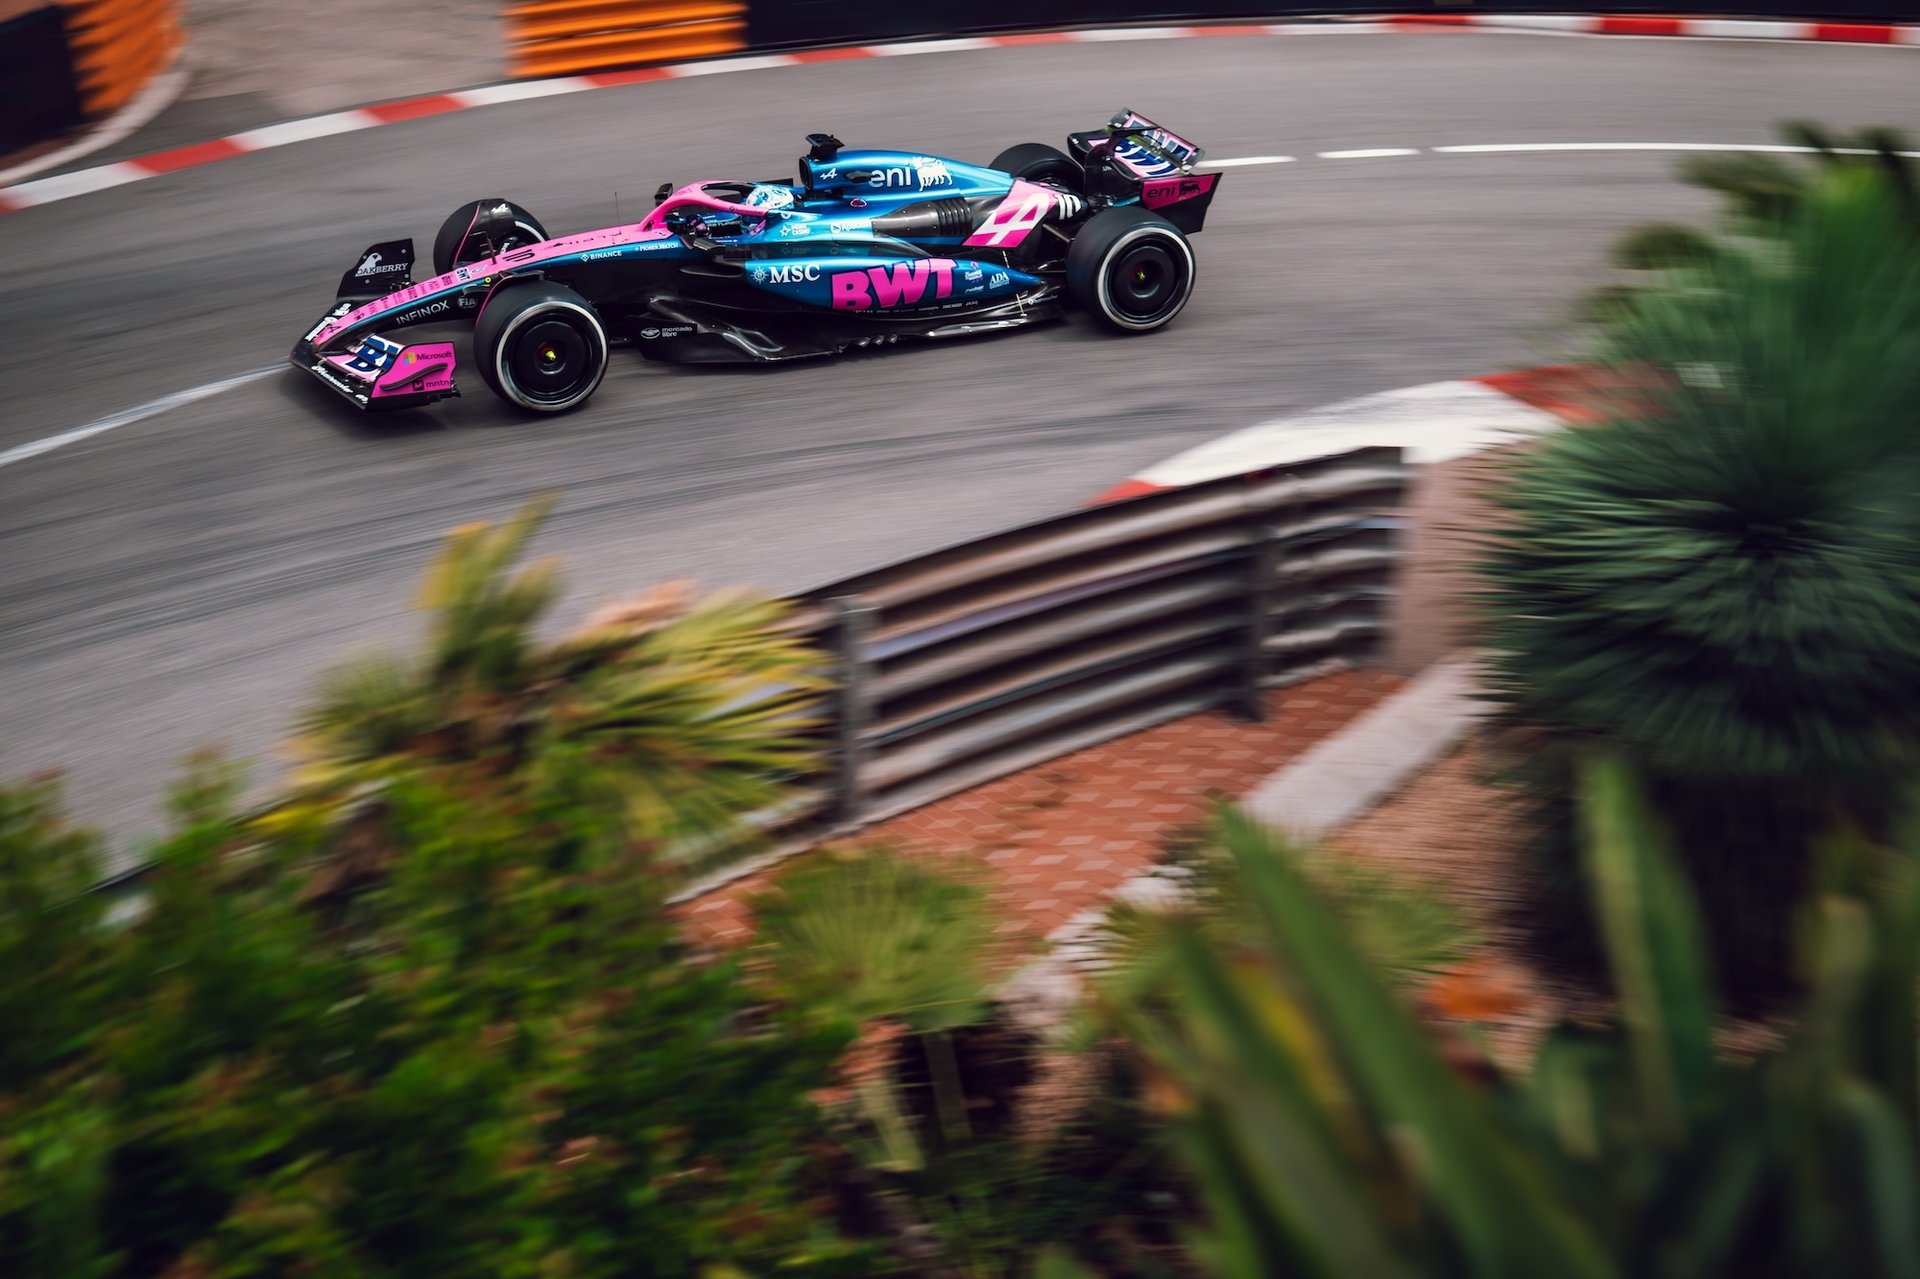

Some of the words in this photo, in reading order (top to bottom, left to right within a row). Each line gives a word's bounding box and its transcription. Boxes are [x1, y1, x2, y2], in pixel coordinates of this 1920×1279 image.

[869, 161, 912, 187] eni
[1147, 183, 1176, 198] eni
[590, 250, 622, 260] BINANCE
[357, 263, 408, 276] OAKBERRY
[769, 263, 820, 284] MSC
[991, 271, 1009, 283] ADA
[832, 258, 957, 311] BWT
[460, 298, 476, 306] FIA
[396, 300, 450, 325] INFINOX
[417, 351, 452, 361] Microsoft
[425, 380, 449, 388] mntn
